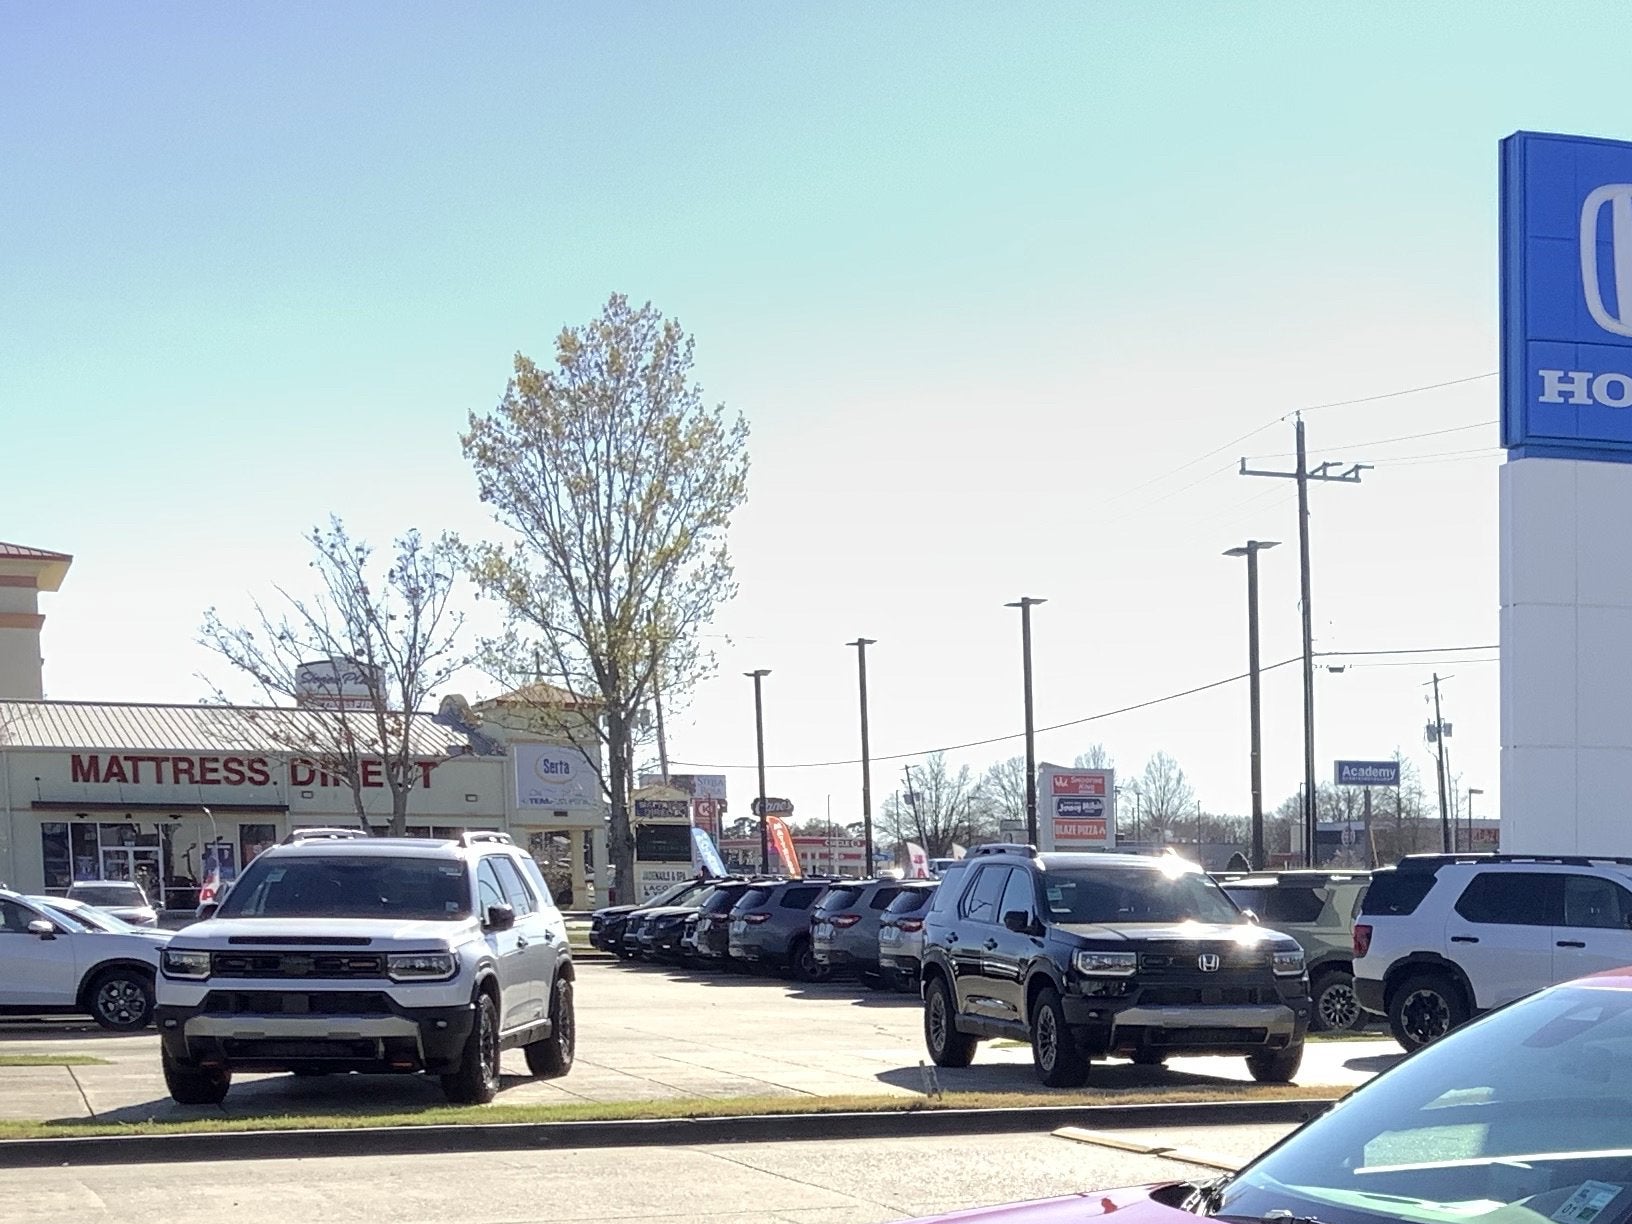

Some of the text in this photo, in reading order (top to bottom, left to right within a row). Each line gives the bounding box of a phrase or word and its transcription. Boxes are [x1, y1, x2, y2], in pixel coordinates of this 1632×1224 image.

[71, 754, 438, 789] MATTRESS DIET
[543, 758, 570, 775] Serta
[1342, 765, 1396, 780] Academy
[1077, 825, 1098, 835] PIZZA
